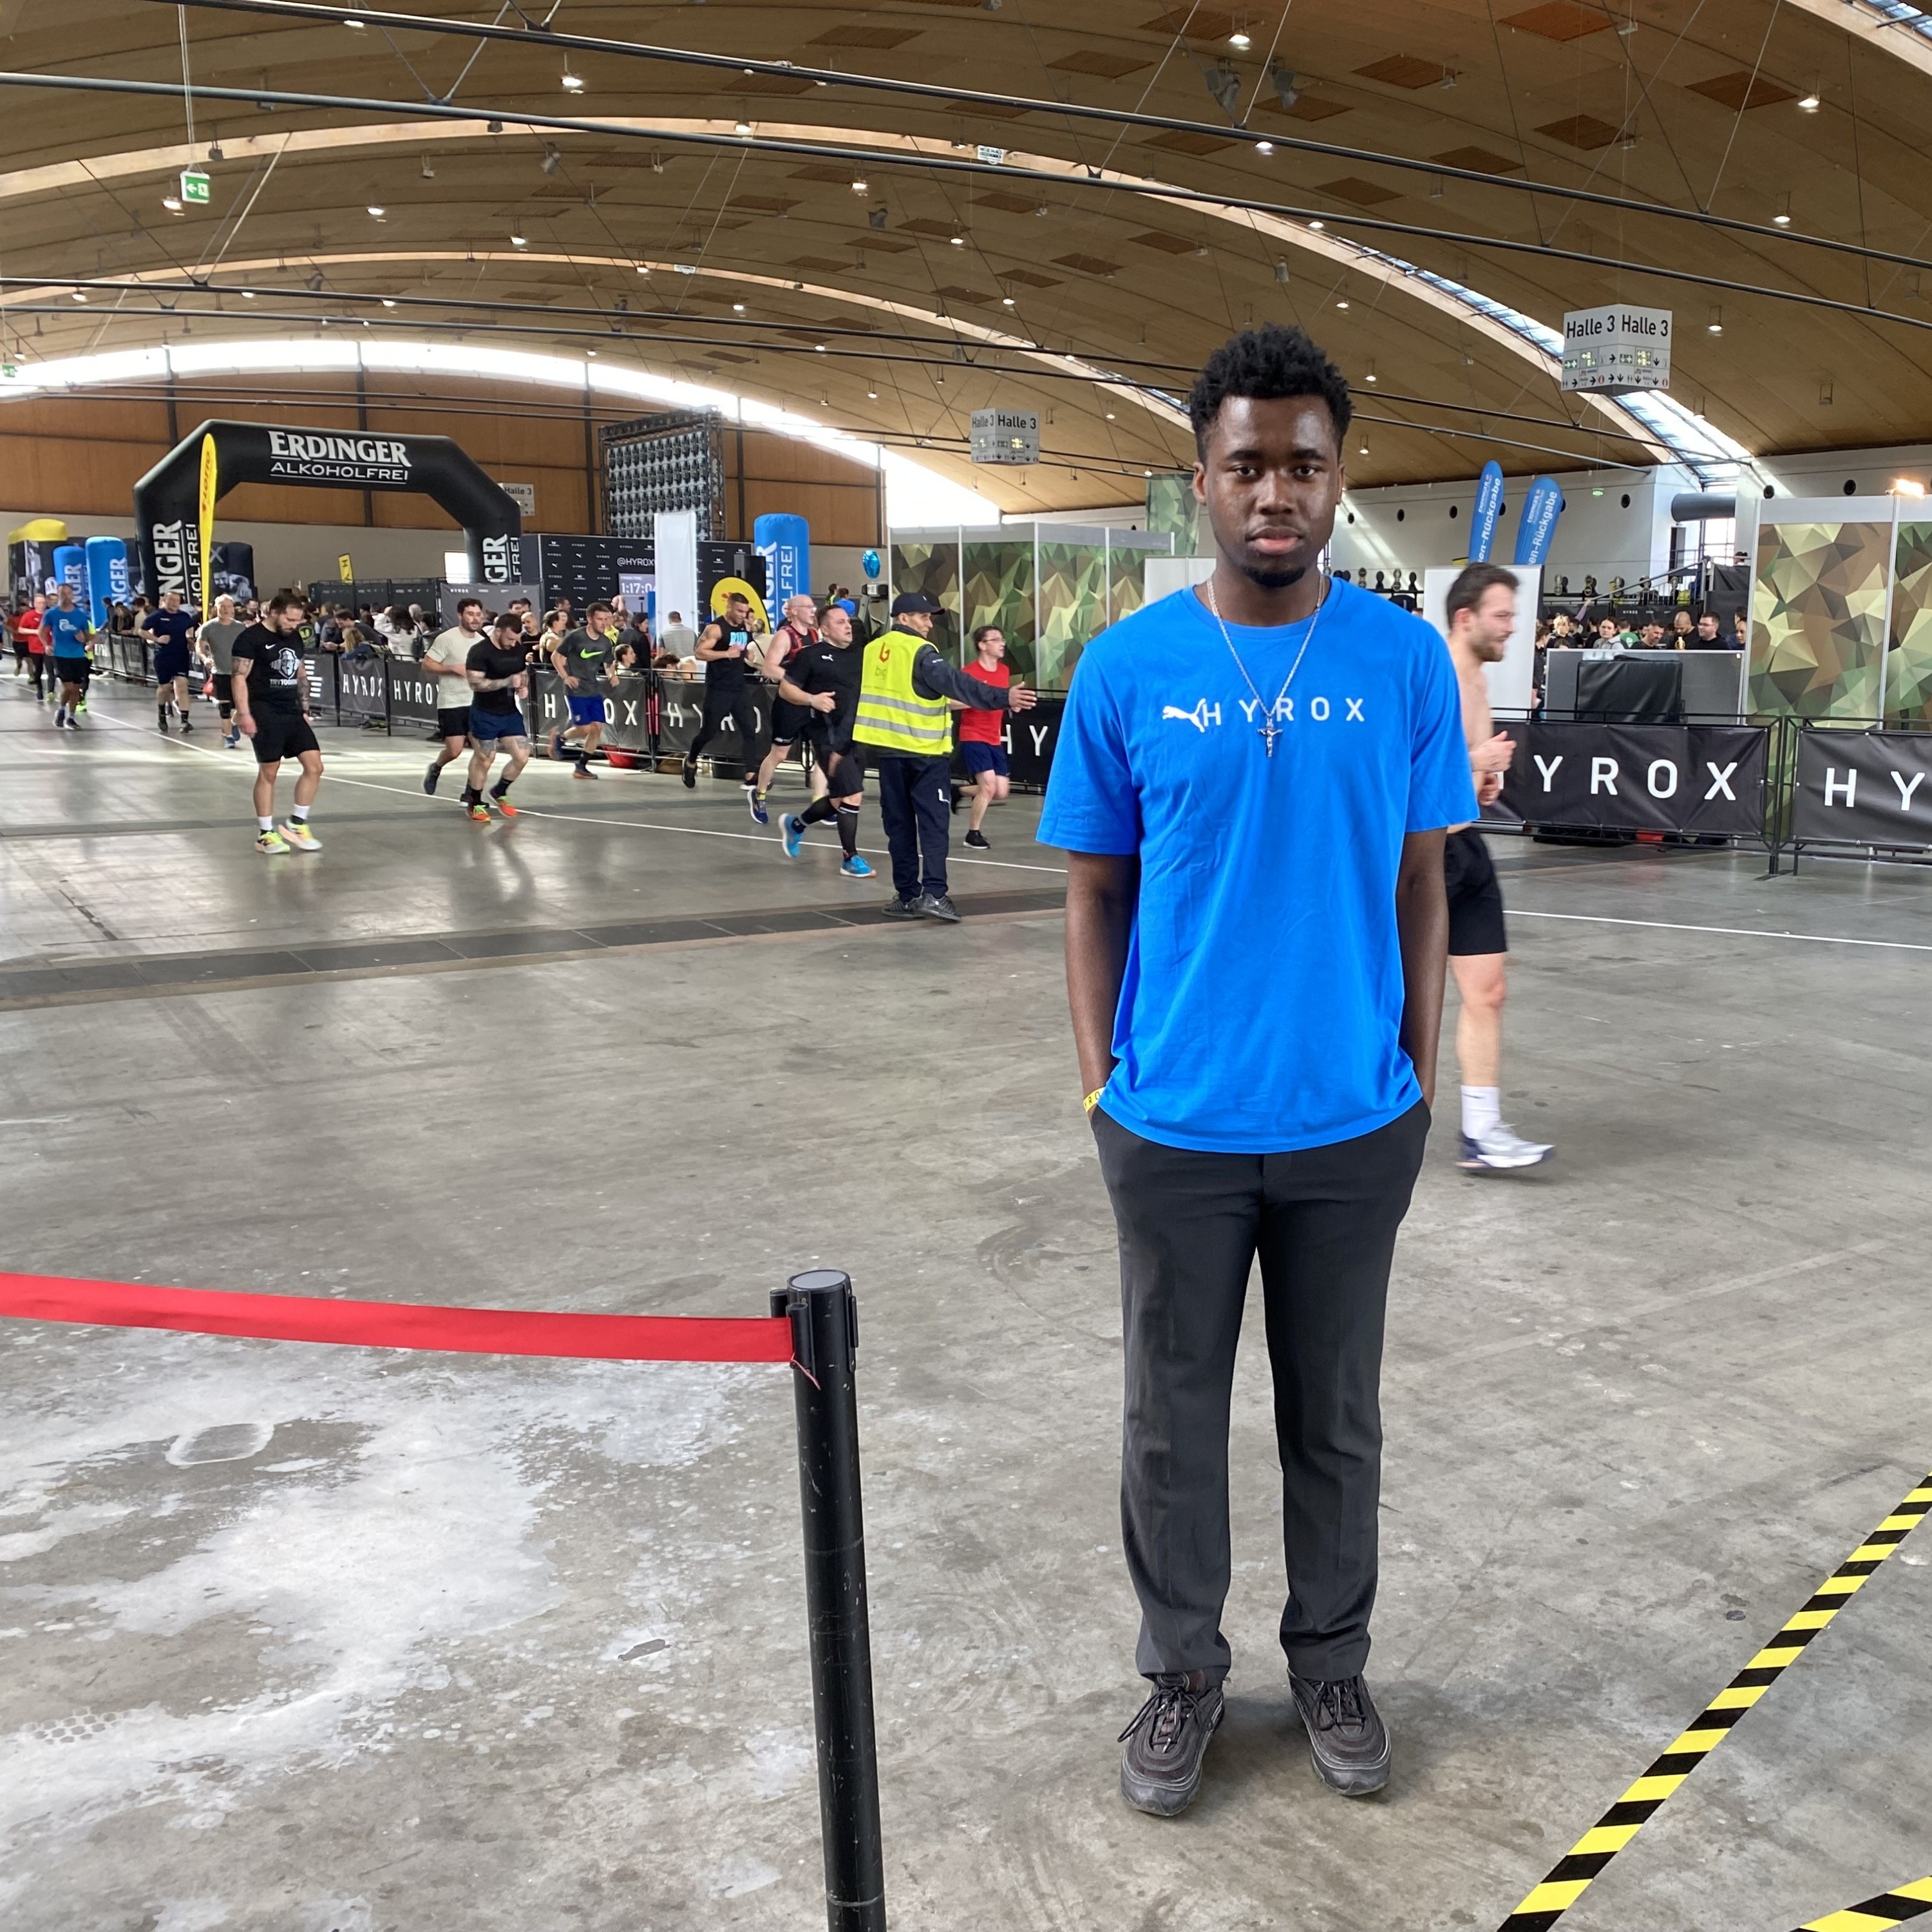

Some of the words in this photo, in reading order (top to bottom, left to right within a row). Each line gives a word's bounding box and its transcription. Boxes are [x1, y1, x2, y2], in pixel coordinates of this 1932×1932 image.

[1567, 318, 1602, 339] Halle
[1607, 315, 1615, 332] 3
[1622, 314, 1656, 336] Halle
[1660, 319, 1669, 337] 3
[972, 416, 989, 428] Halle
[990, 414, 994, 426] 3
[998, 414, 1027, 429] Halle
[1030, 417, 1037, 430] 3
[268, 431, 412, 467] ERDINGER
[270, 462, 408, 480] ALKOHOLFREI
[617, 557, 655, 567] @HYROX
[544, 693, 638, 726] HOX
[1202, 697, 1365, 727] HYROX
